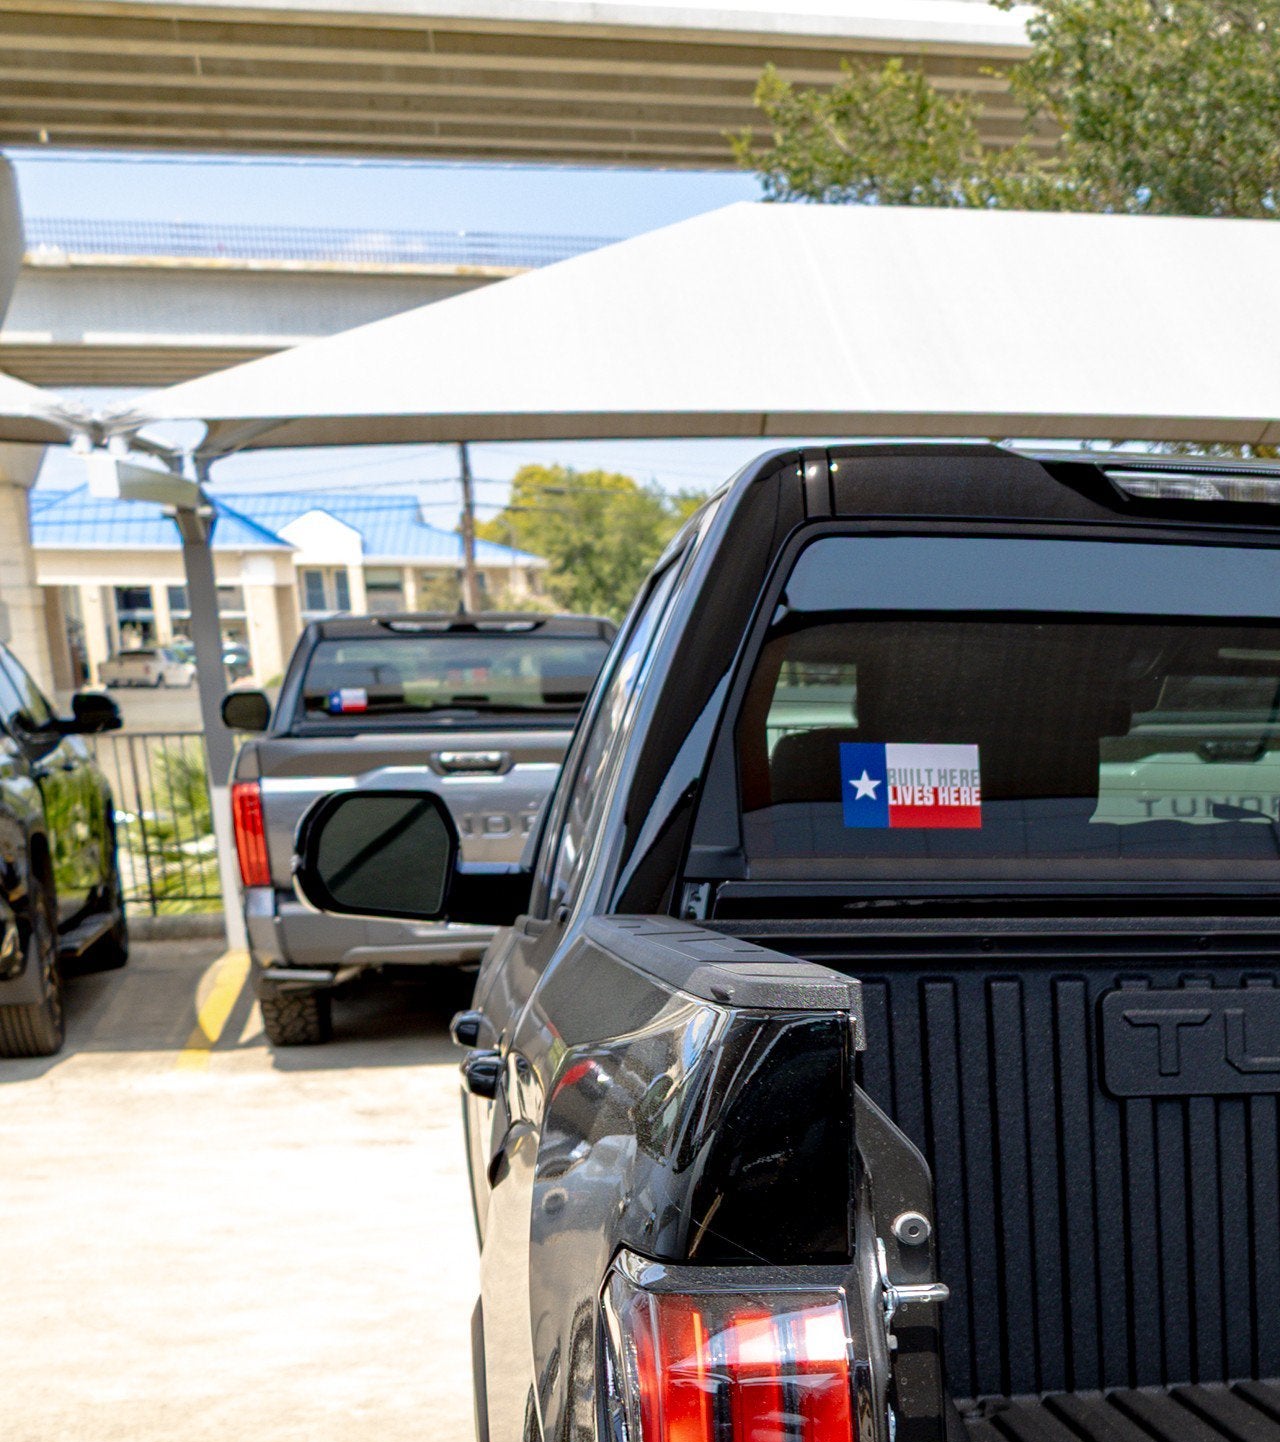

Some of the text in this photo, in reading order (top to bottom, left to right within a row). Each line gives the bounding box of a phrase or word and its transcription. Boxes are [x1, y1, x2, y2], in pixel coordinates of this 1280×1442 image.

[887, 768, 980, 787] BUILT HERE
[888, 786, 982, 806] LIVES HERE
